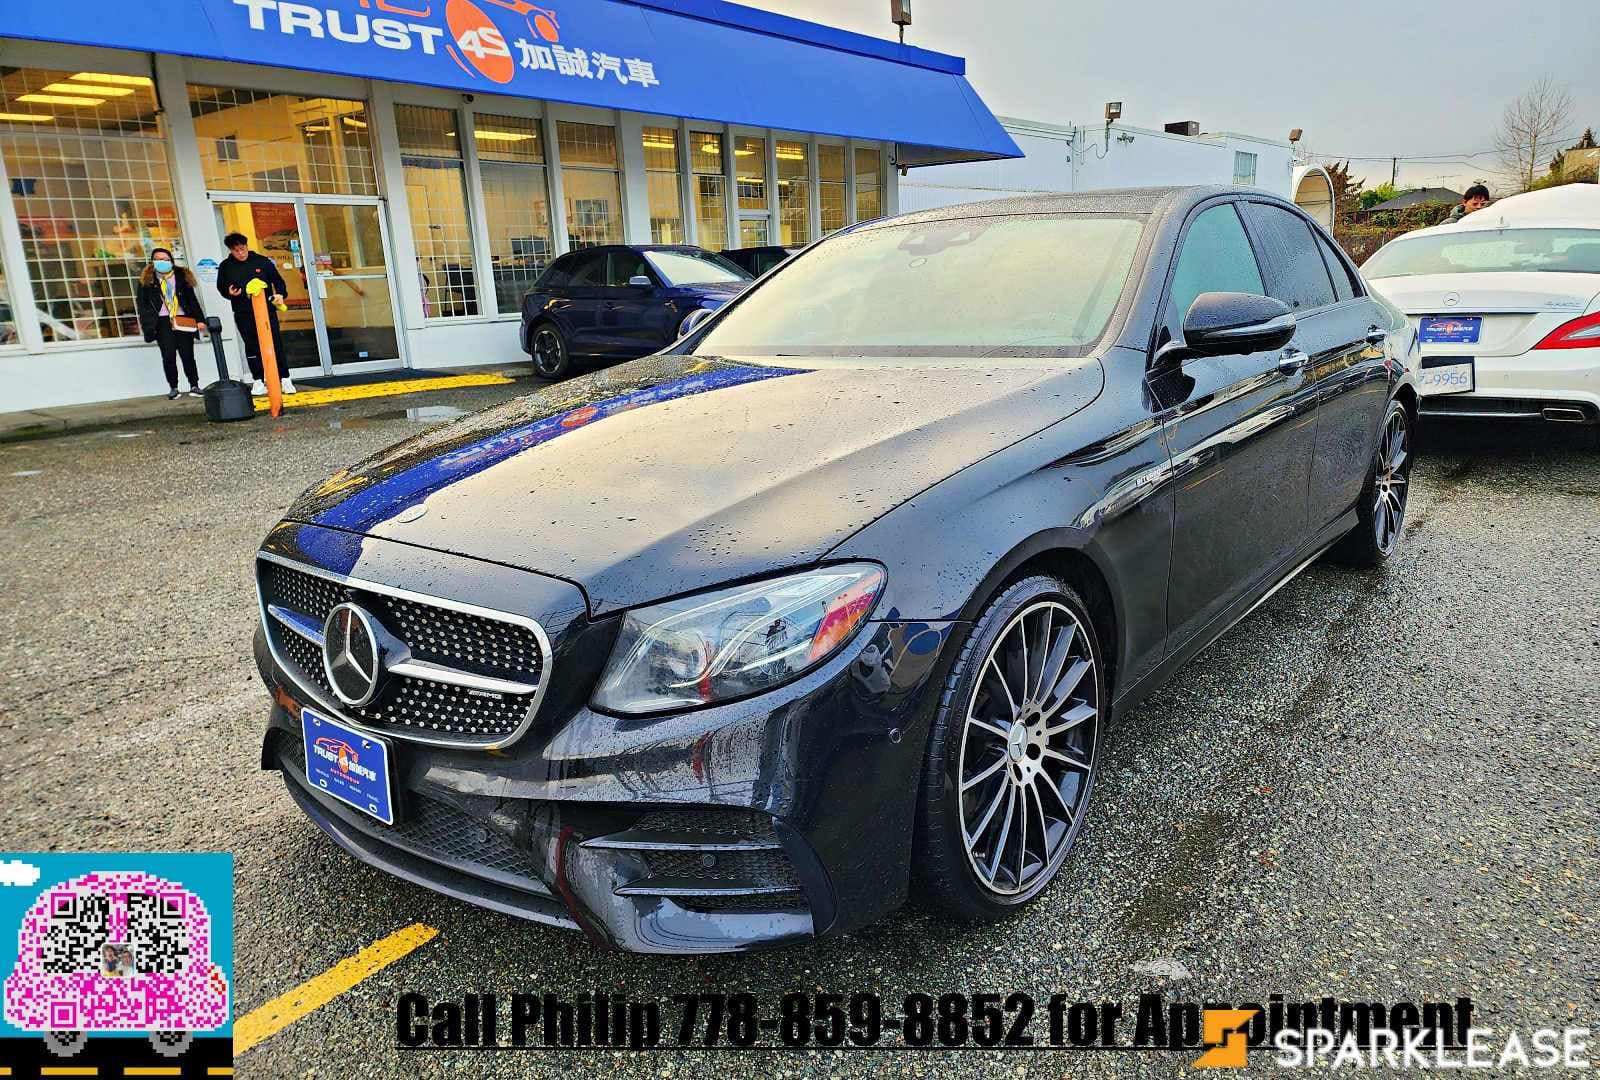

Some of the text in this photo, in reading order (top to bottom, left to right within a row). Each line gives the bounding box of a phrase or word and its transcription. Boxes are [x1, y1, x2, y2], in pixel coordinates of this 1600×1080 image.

[233, 0, 512, 60] TRUST 4S
[514, 37, 660, 88] 加誠汽車
[313, 744, 339, 764] TRUST
